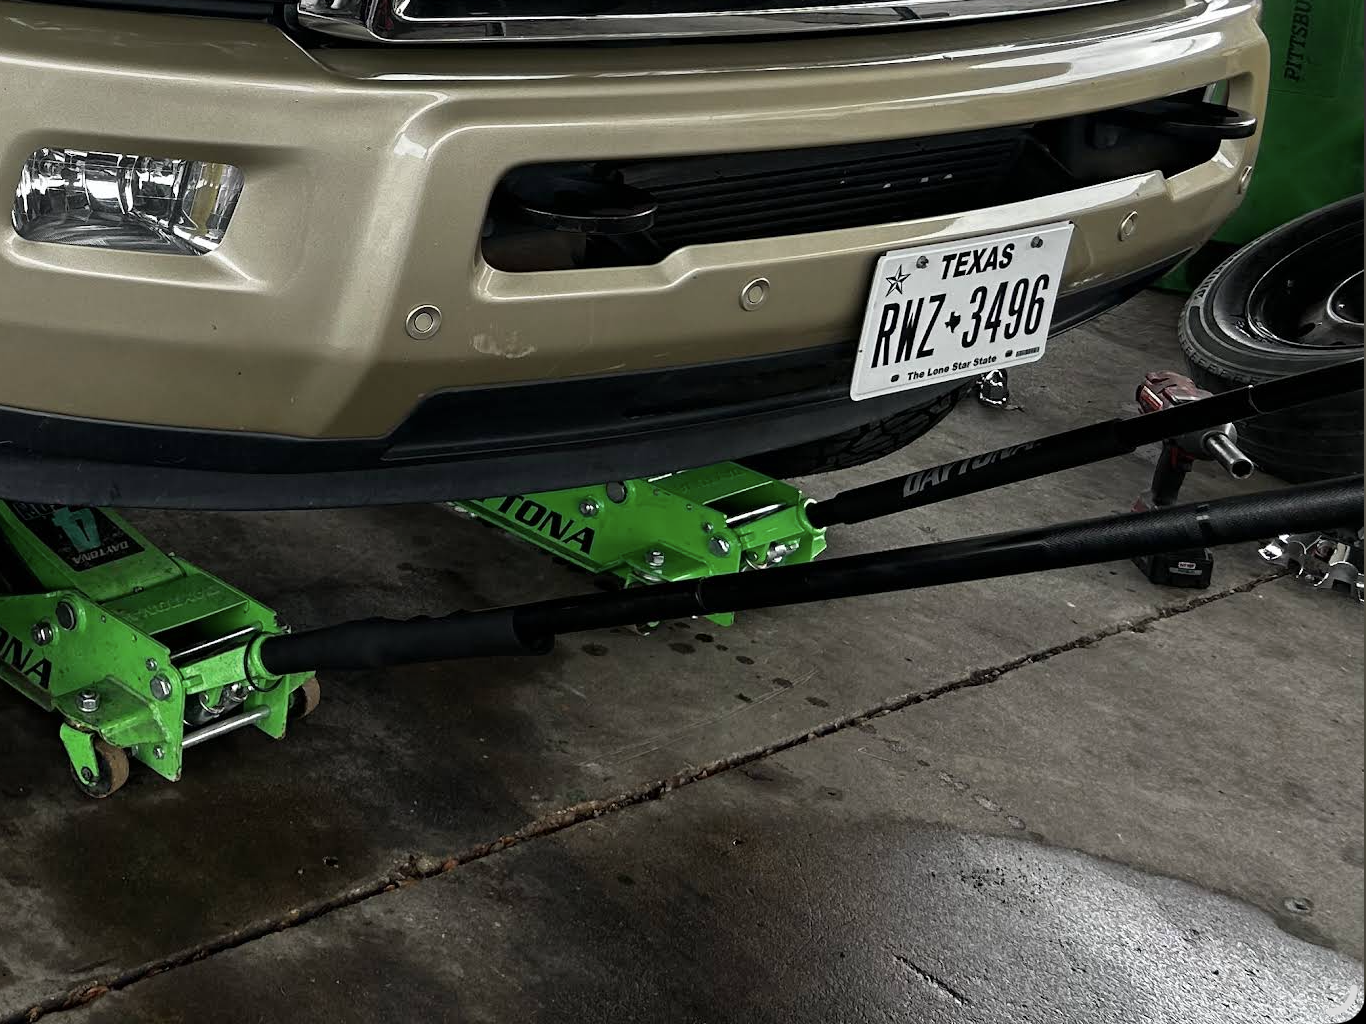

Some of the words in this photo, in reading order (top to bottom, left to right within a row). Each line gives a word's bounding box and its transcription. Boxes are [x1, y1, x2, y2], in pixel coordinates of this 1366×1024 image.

[941, 243, 1016, 280] TEXAS
[907, 370, 925, 381] The
[927, 365, 950, 377] Lone
[952, 359, 972, 372] Star
[974, 354, 997, 367] State
[496, 494, 596, 555] TONA
